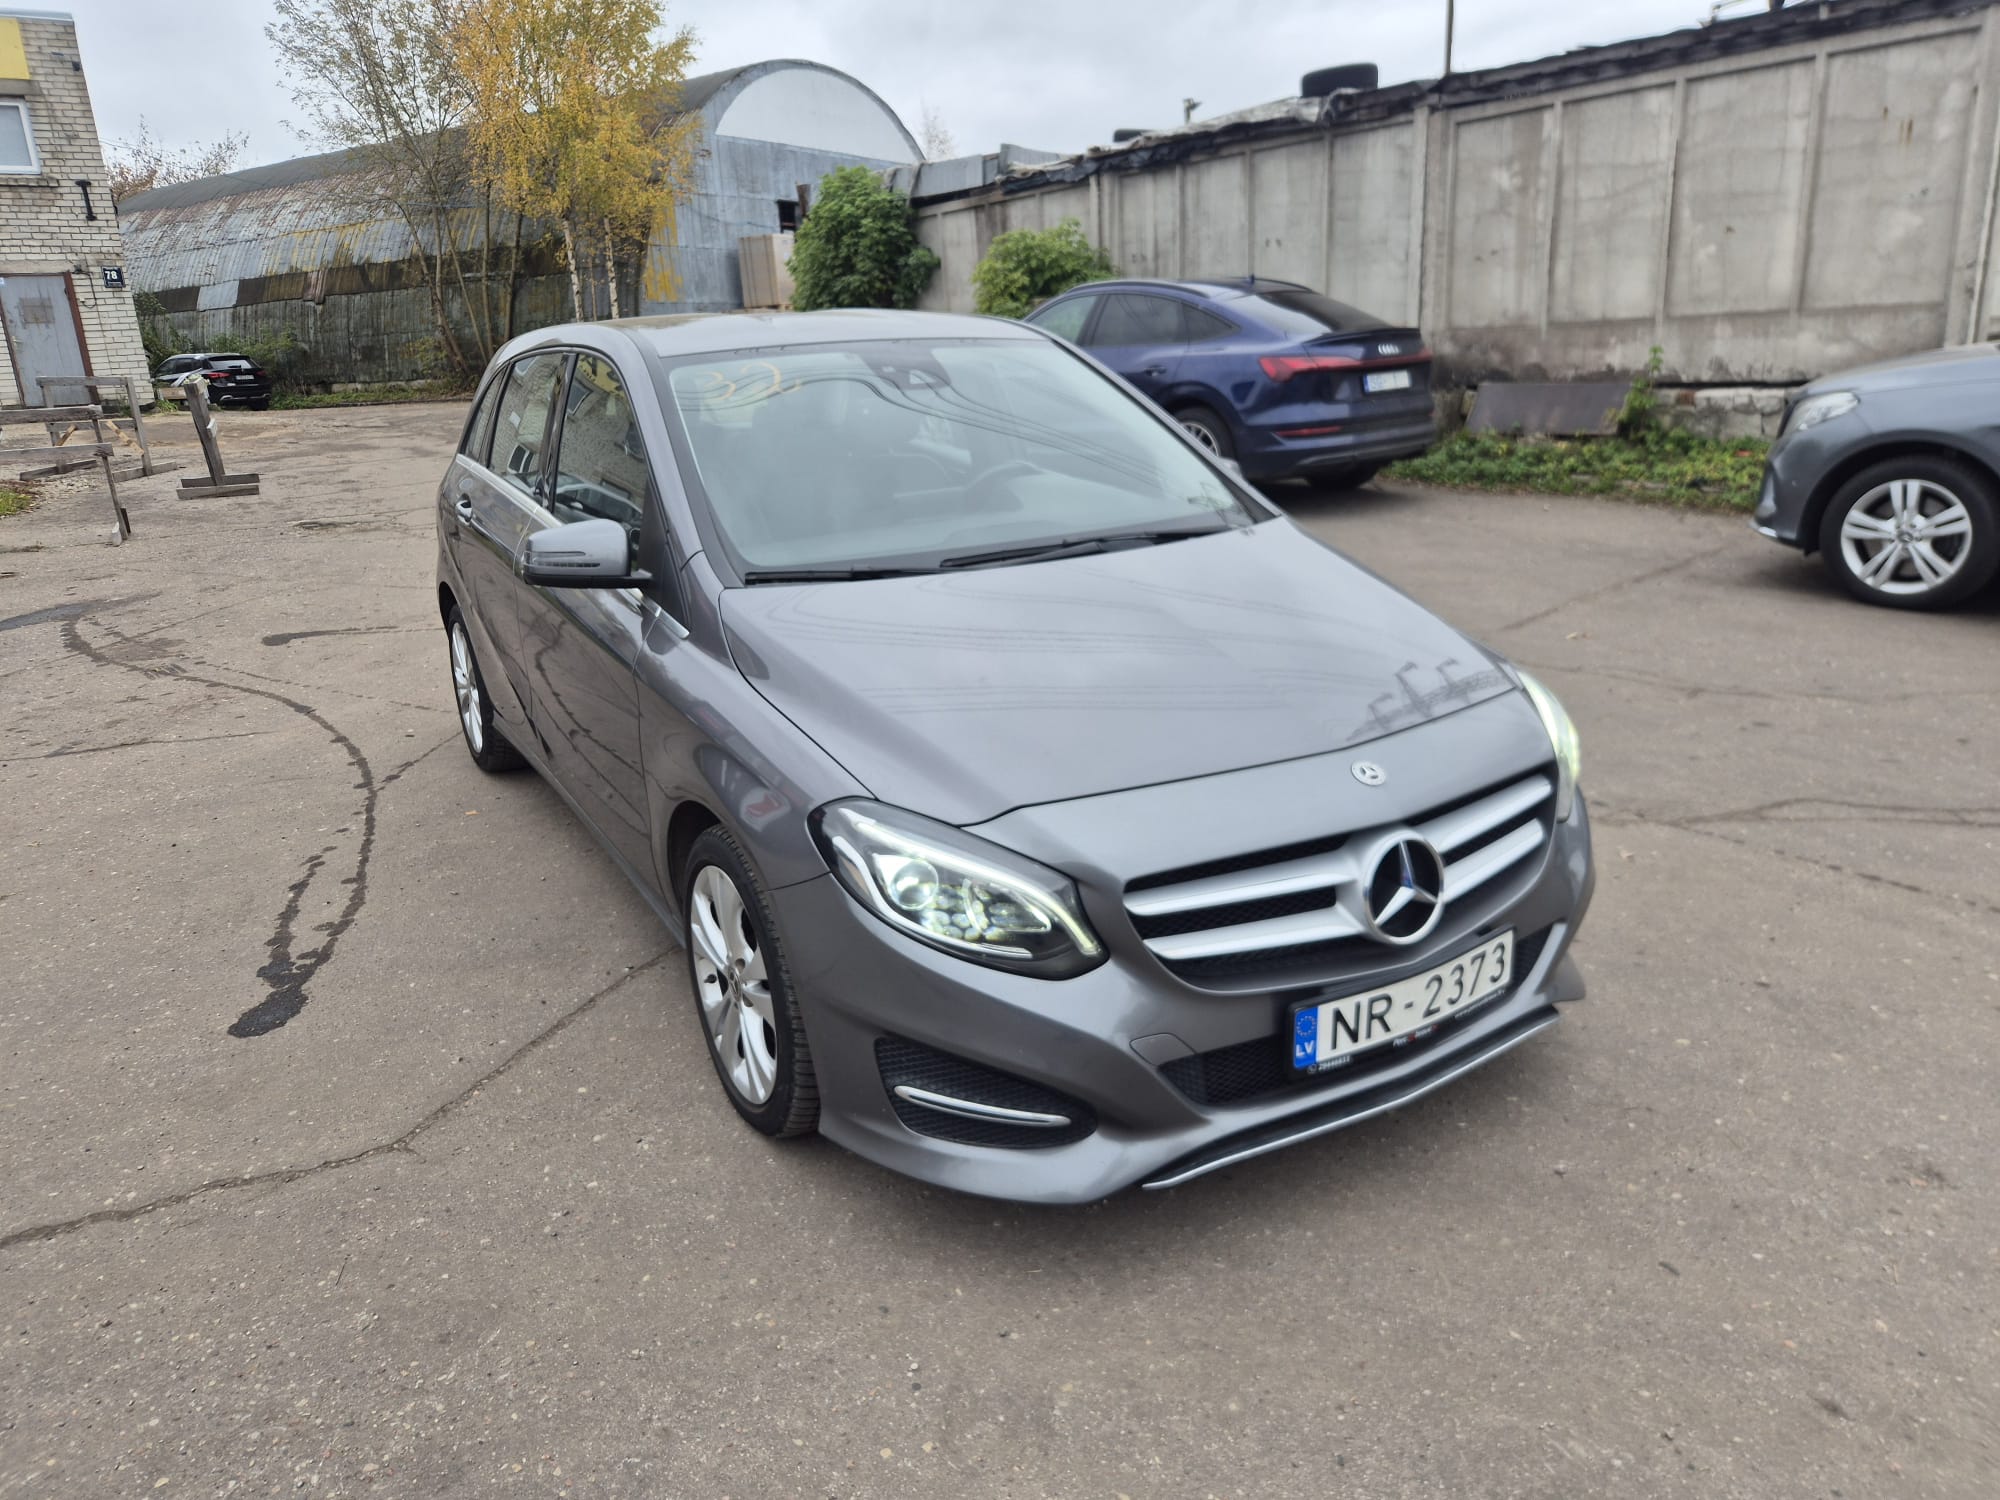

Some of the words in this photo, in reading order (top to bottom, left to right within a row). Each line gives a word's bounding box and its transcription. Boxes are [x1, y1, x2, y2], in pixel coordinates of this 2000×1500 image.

[104, 270, 118, 280] 78
[1330, 940, 1507, 1051] NR-2373
[1295, 1039, 1315, 1058] LV
